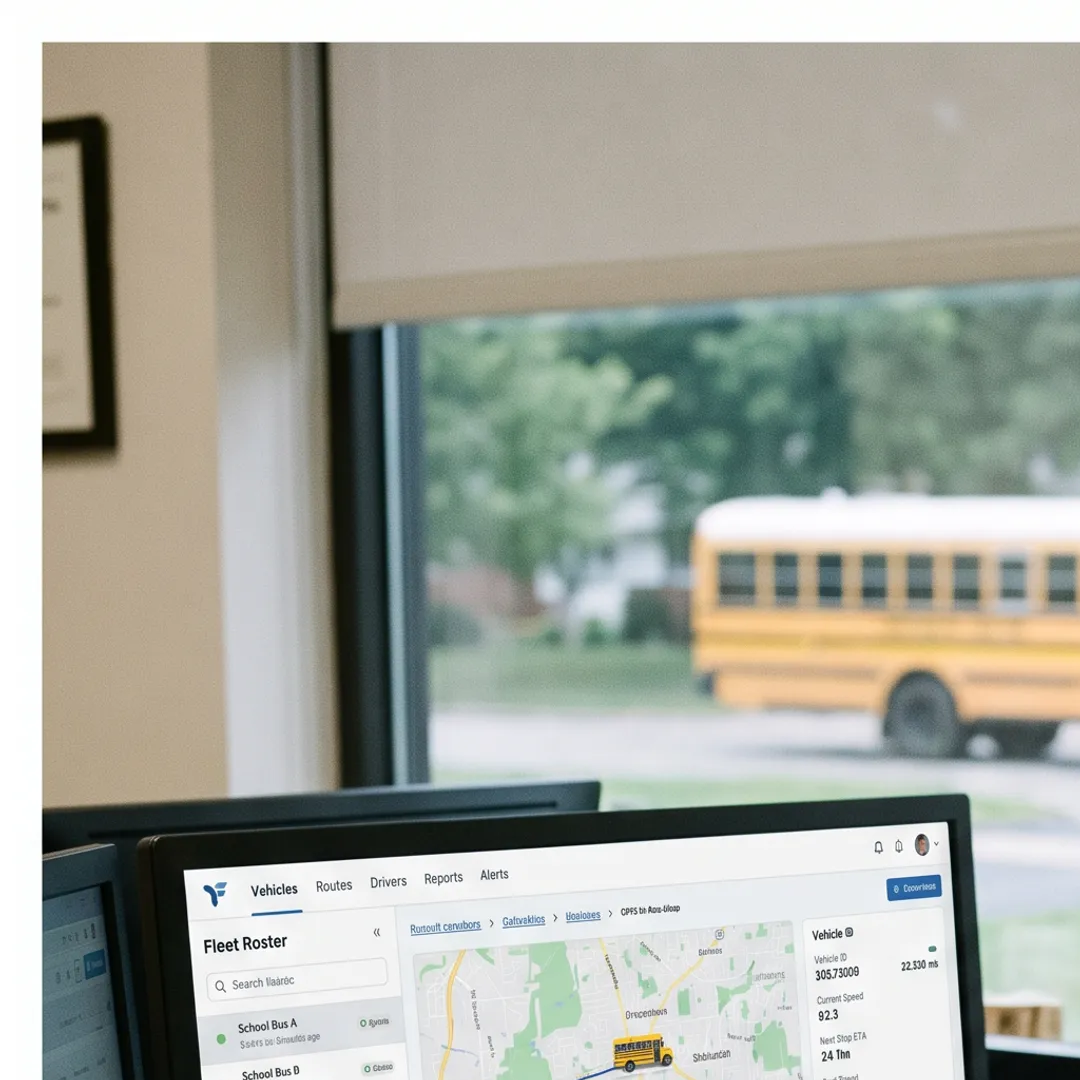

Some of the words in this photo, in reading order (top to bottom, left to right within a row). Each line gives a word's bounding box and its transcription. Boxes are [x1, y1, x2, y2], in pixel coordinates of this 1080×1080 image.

[424, 871, 464, 886] Reports
[480, 868, 509, 881] Alerts
[316, 880, 353, 893] Routes
[370, 876, 407, 889] Drivers
[250, 883, 298, 898] Vehicles
[812, 928, 843, 941] Vehicle
[203, 938, 239, 954] Fleet
[242, 935, 288, 951] Roster
[814, 953, 839, 964] Vehicle
[232, 978, 263, 990] Search
[817, 993, 842, 1005] Current
[842, 992, 864, 1003] Speed
[818, 1009, 839, 1021] 92.3
[238, 1020, 270, 1034] School
[271, 1019, 289, 1030] Bus
[290, 1018, 298, 1028] A
[820, 1036, 836, 1045] Next
[836, 1034, 852, 1043] Stop
[853, 1031, 867, 1041] ETA
[821, 1050, 834, 1062] 24
[275, 1067, 293, 1077] Bus
